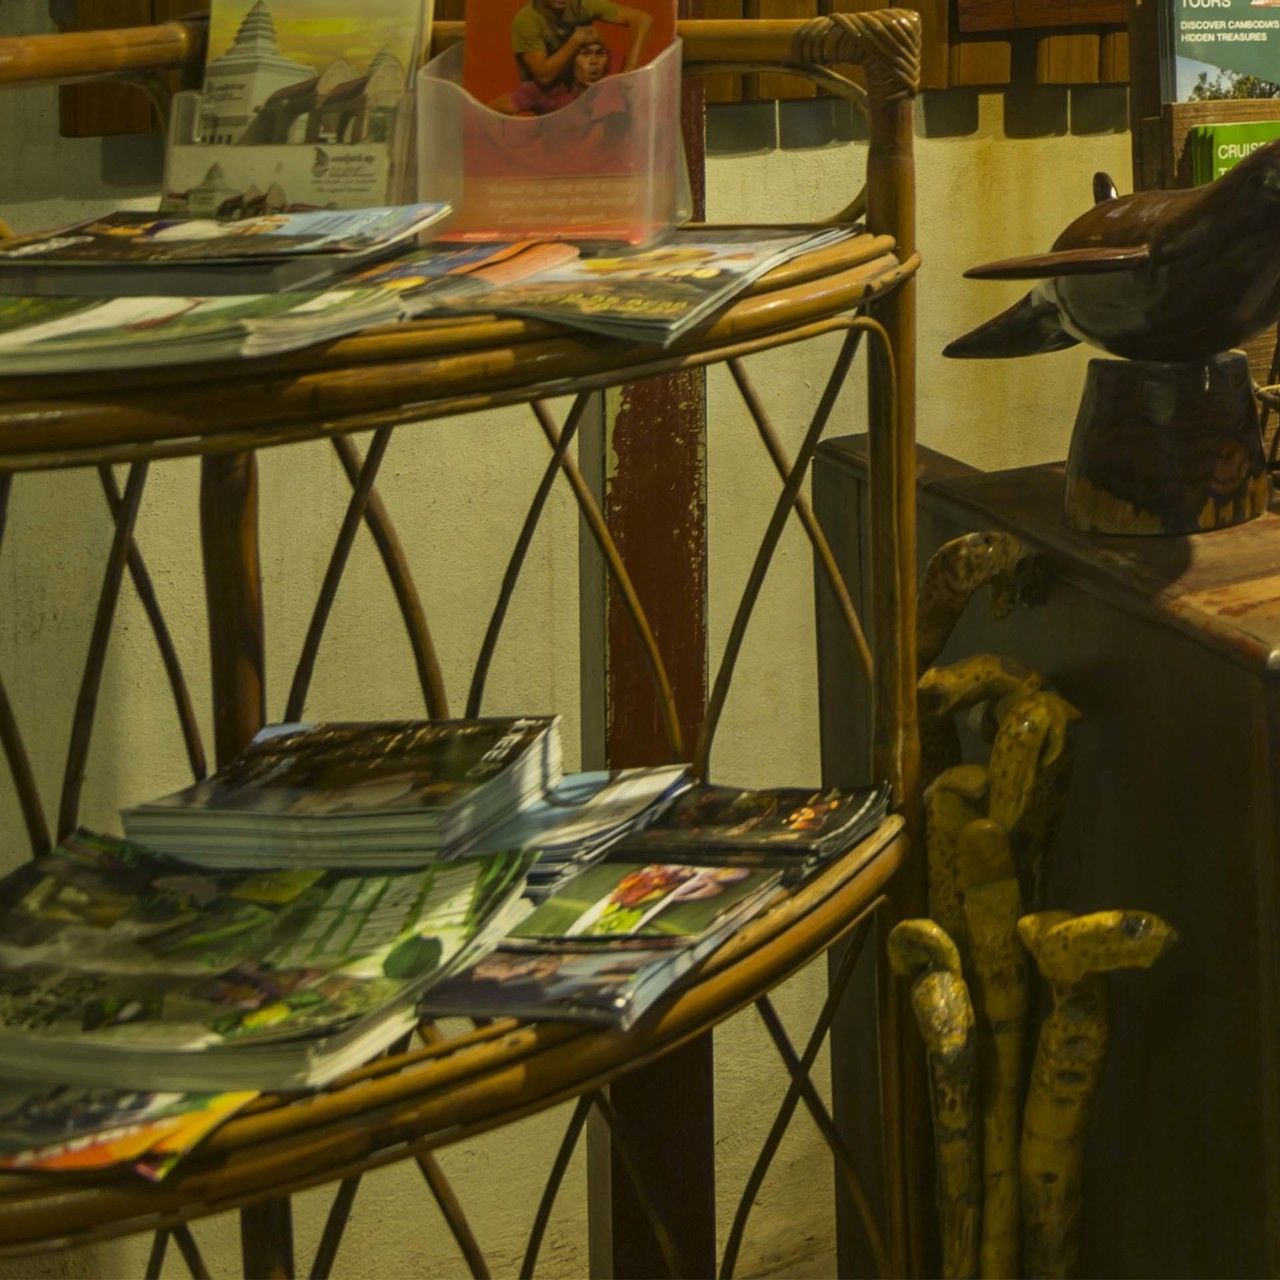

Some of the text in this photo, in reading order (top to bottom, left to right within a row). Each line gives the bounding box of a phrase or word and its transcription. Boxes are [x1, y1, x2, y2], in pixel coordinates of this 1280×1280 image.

[1180, 20, 1226, 30] DISCOVER
[1181, 32, 1268, 42] HIDDEN TREASURES
